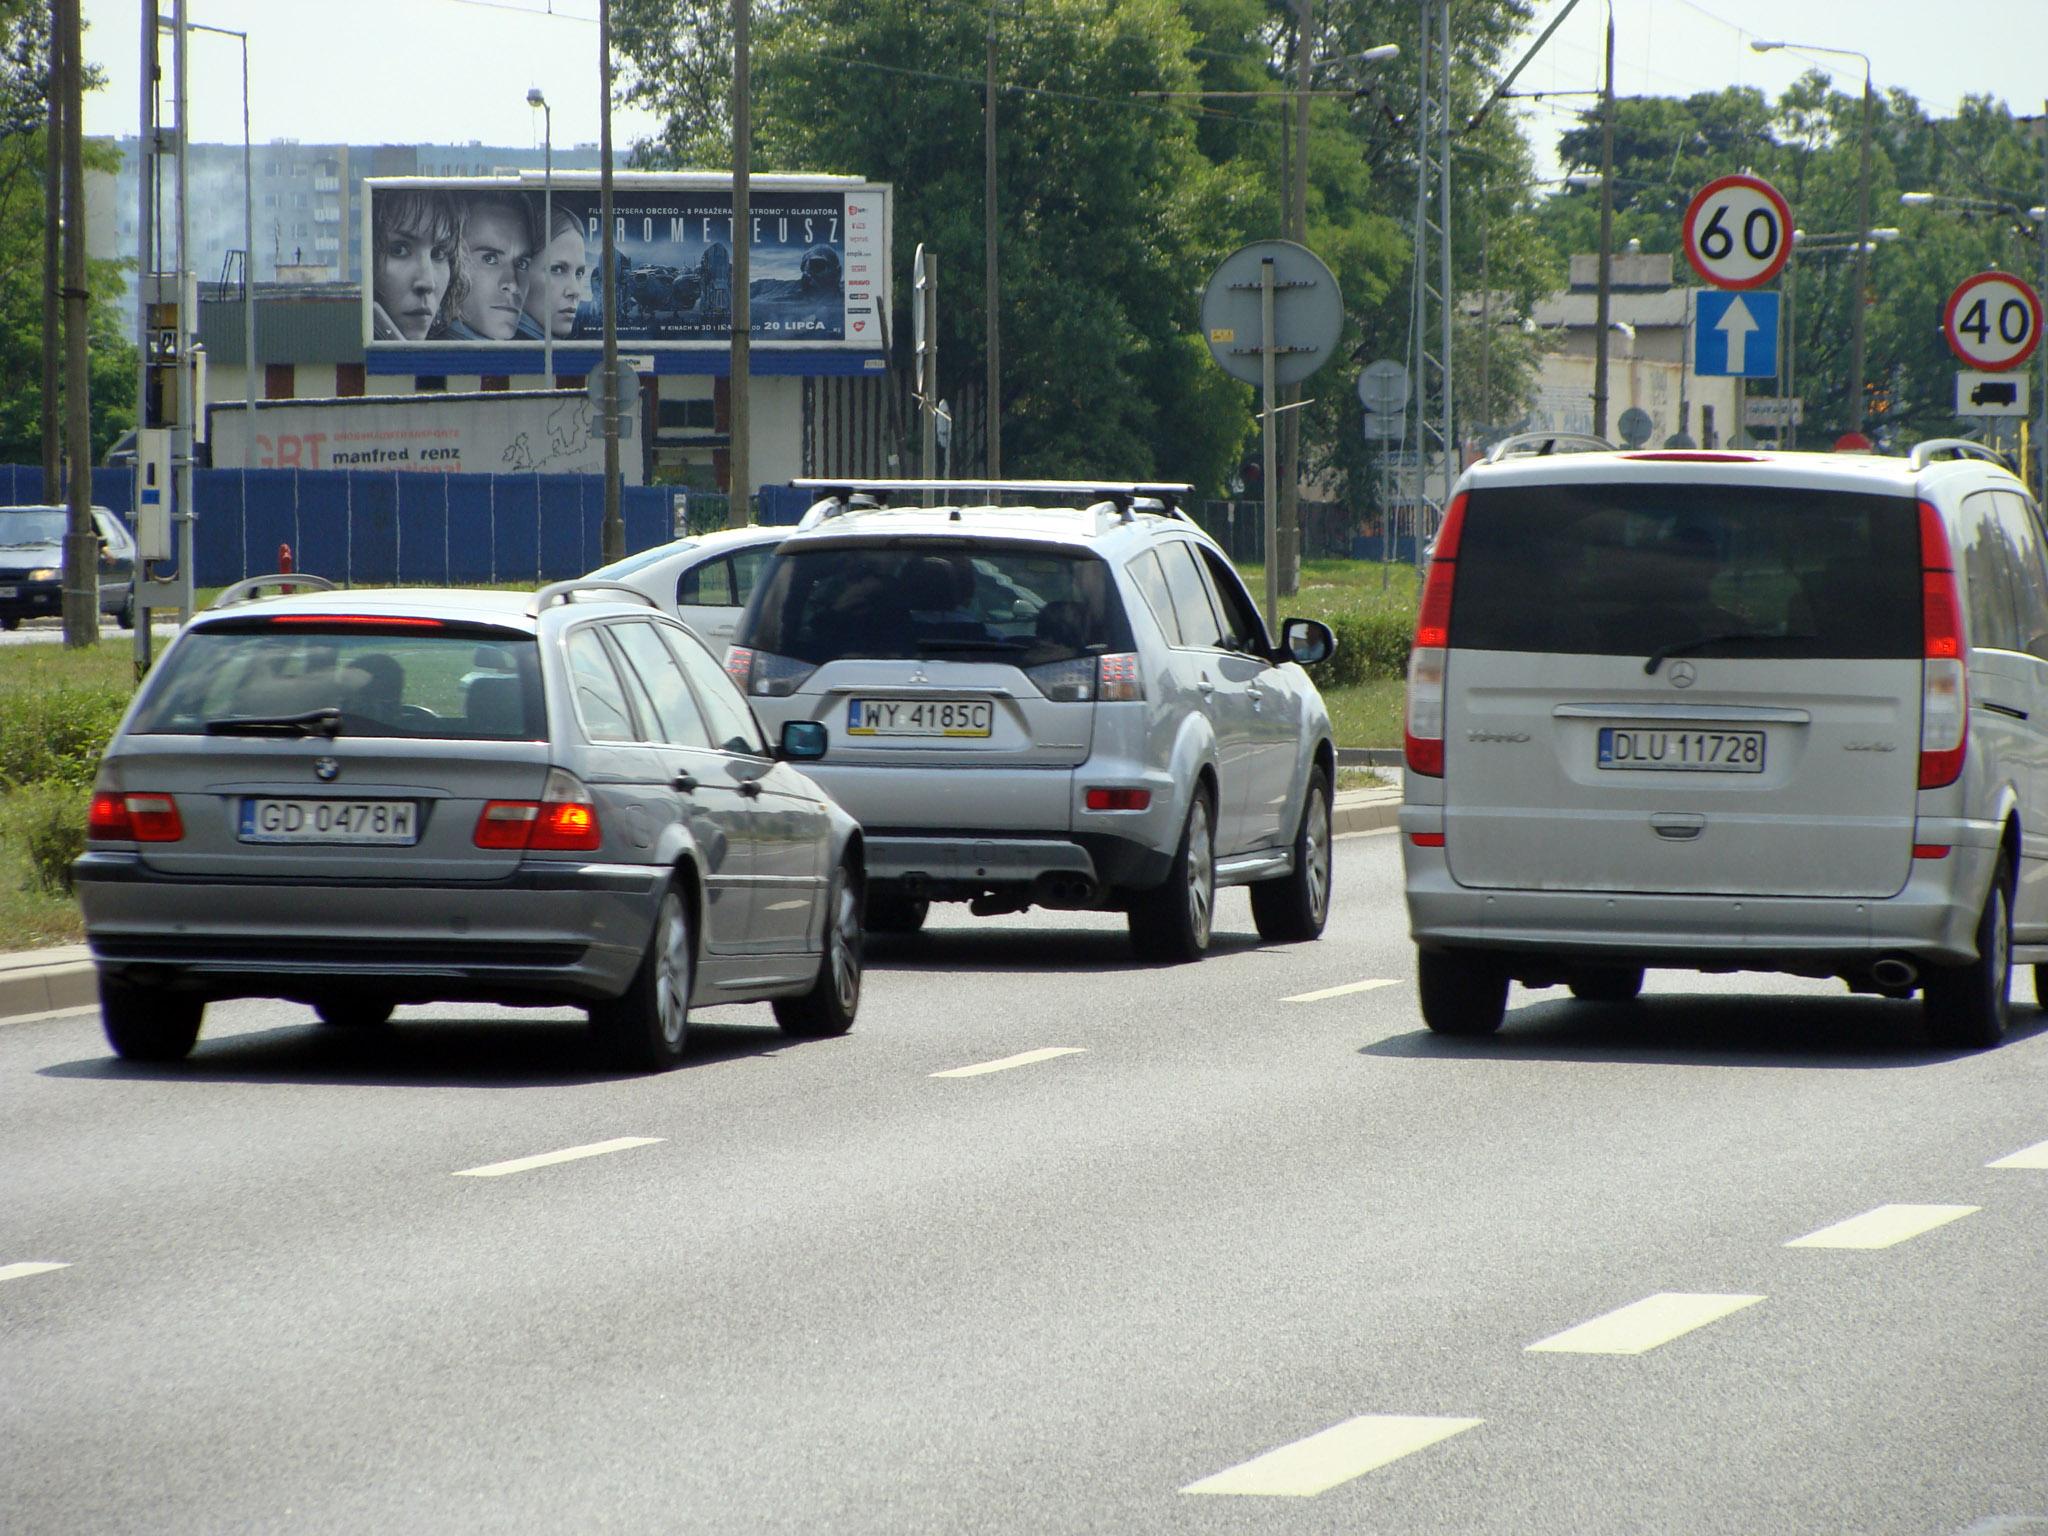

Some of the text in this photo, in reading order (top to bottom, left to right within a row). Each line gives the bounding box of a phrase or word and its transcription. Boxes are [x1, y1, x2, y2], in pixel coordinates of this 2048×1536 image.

[646, 207, 679, 215] OBCEGO
[589, 217, 839, 243] PROMETEUSZ
[1700, 205, 1778, 260] 60
[763, 321, 780, 330] 20
[785, 321, 826, 330] LIPCA
[1960, 298, 2030, 344] 40
[333, 448, 460, 464] manfred renz
[865, 704, 986, 728] WY 4185C
[1616, 734, 1758, 763] DLU 11728
[261, 804, 411, 833] GD 0478W
